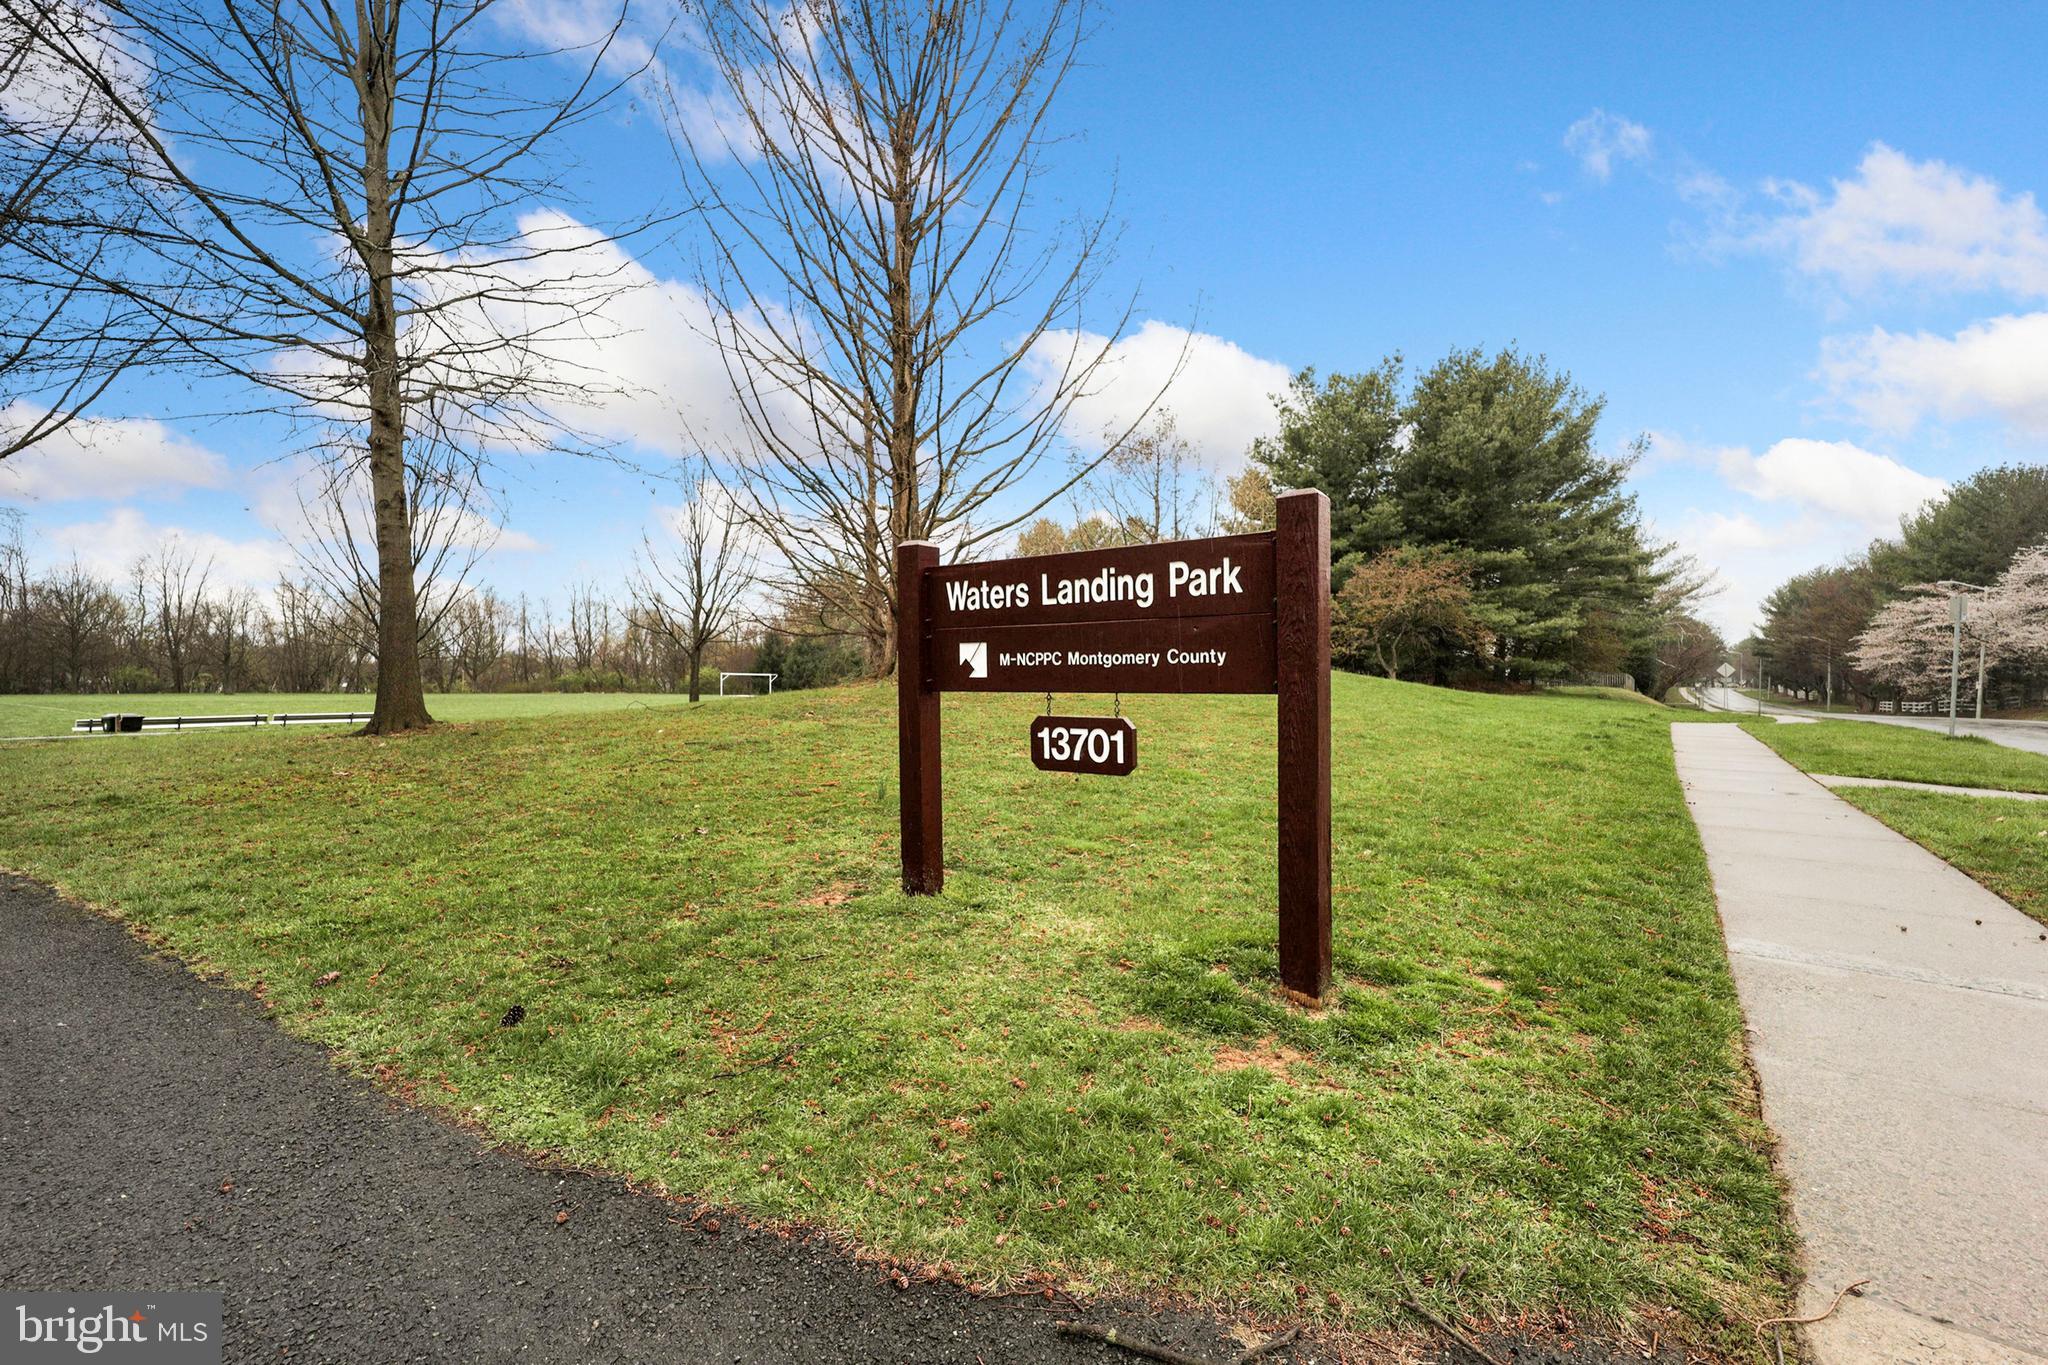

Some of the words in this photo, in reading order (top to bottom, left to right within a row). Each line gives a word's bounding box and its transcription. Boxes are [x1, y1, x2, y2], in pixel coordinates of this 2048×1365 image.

[946, 580, 1030, 612] Waters
[1041, 567, 1154, 608] Landing
[1169, 557, 1243, 598] Park
[999, 651, 1062, 667] M-NCPPC
[1067, 650, 1160, 668] Montgomery
[1167, 648, 1226, 667] County
[1037, 726, 1125, 764] 13701
